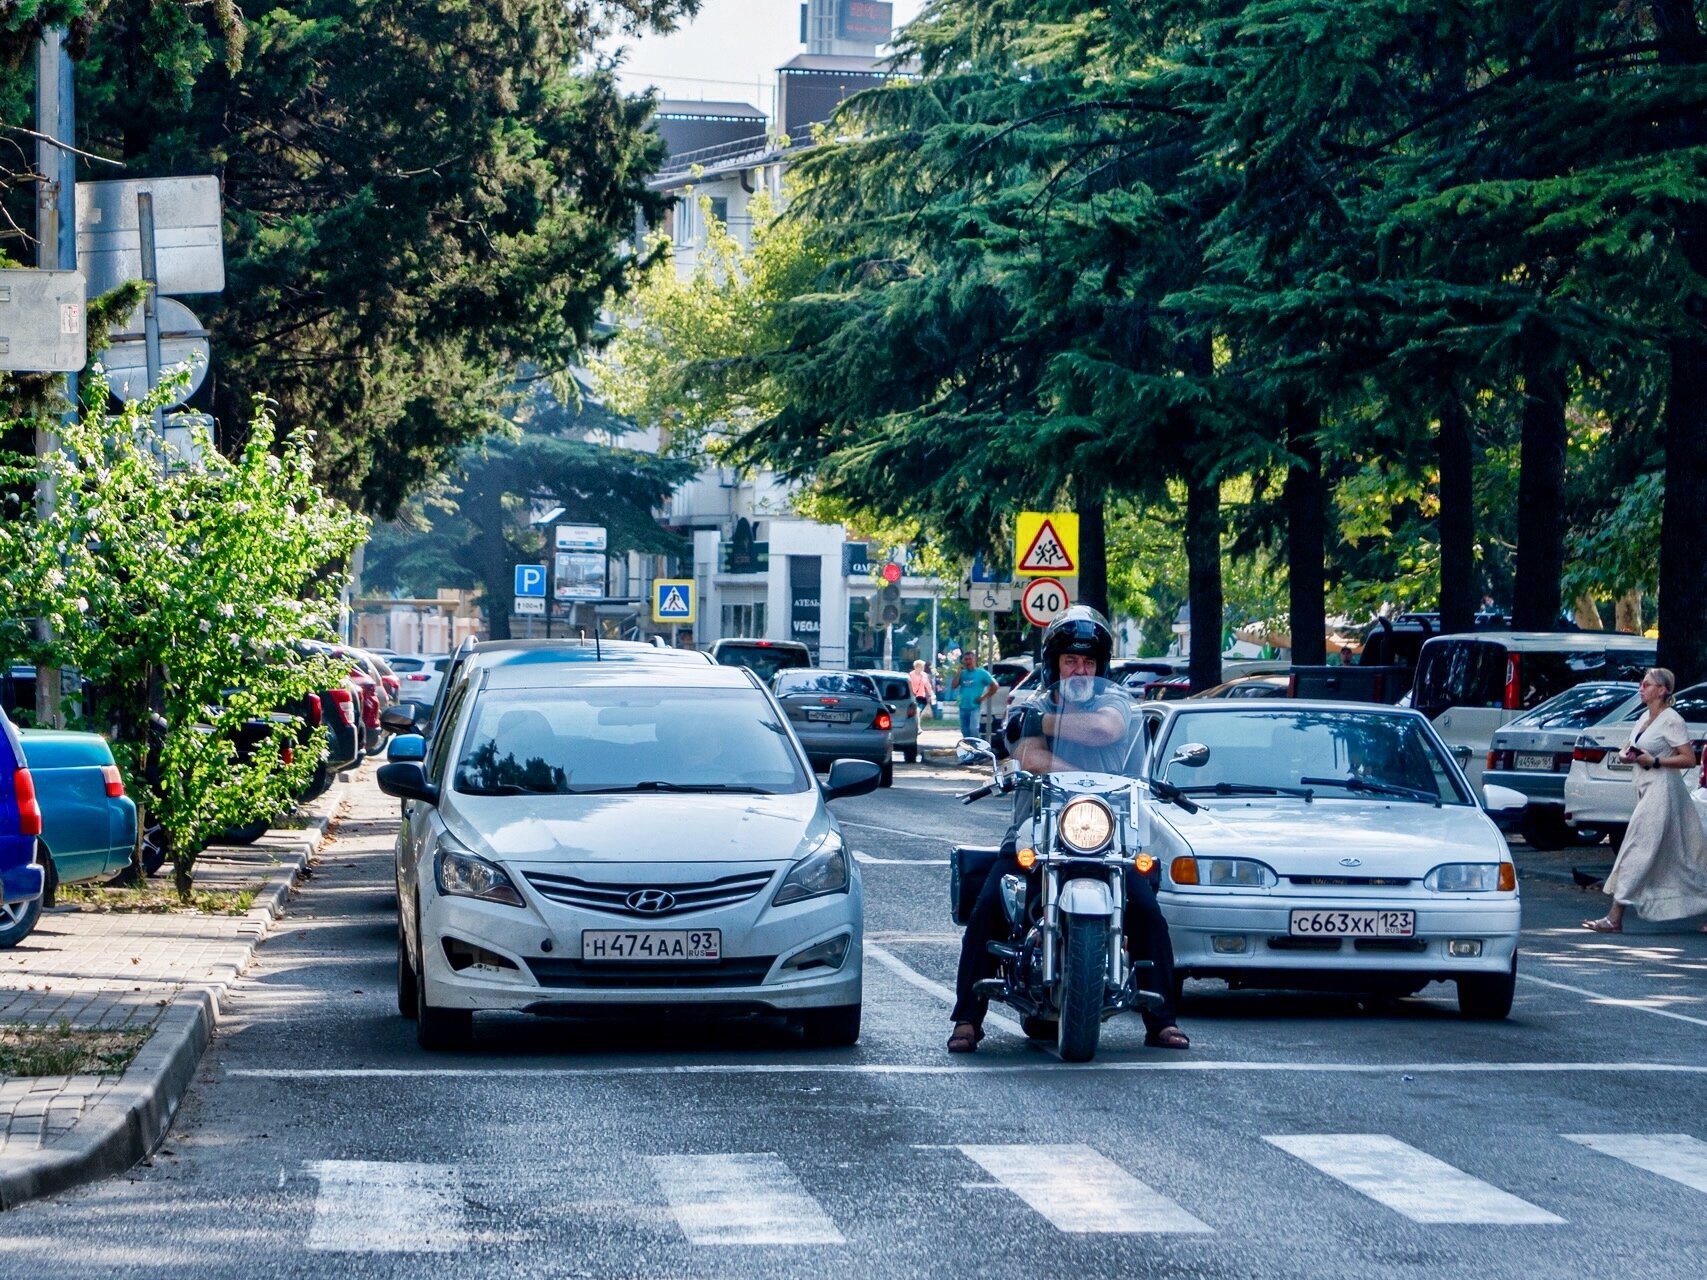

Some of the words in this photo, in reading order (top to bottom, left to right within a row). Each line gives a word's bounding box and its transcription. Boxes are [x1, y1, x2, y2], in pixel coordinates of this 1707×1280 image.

[524, 569, 540, 592] P
[1031, 593, 1059, 612] 40
[793, 621, 820, 631] VEGA
[1380, 913, 1409, 927] 123
[690, 933, 712, 949] 93
